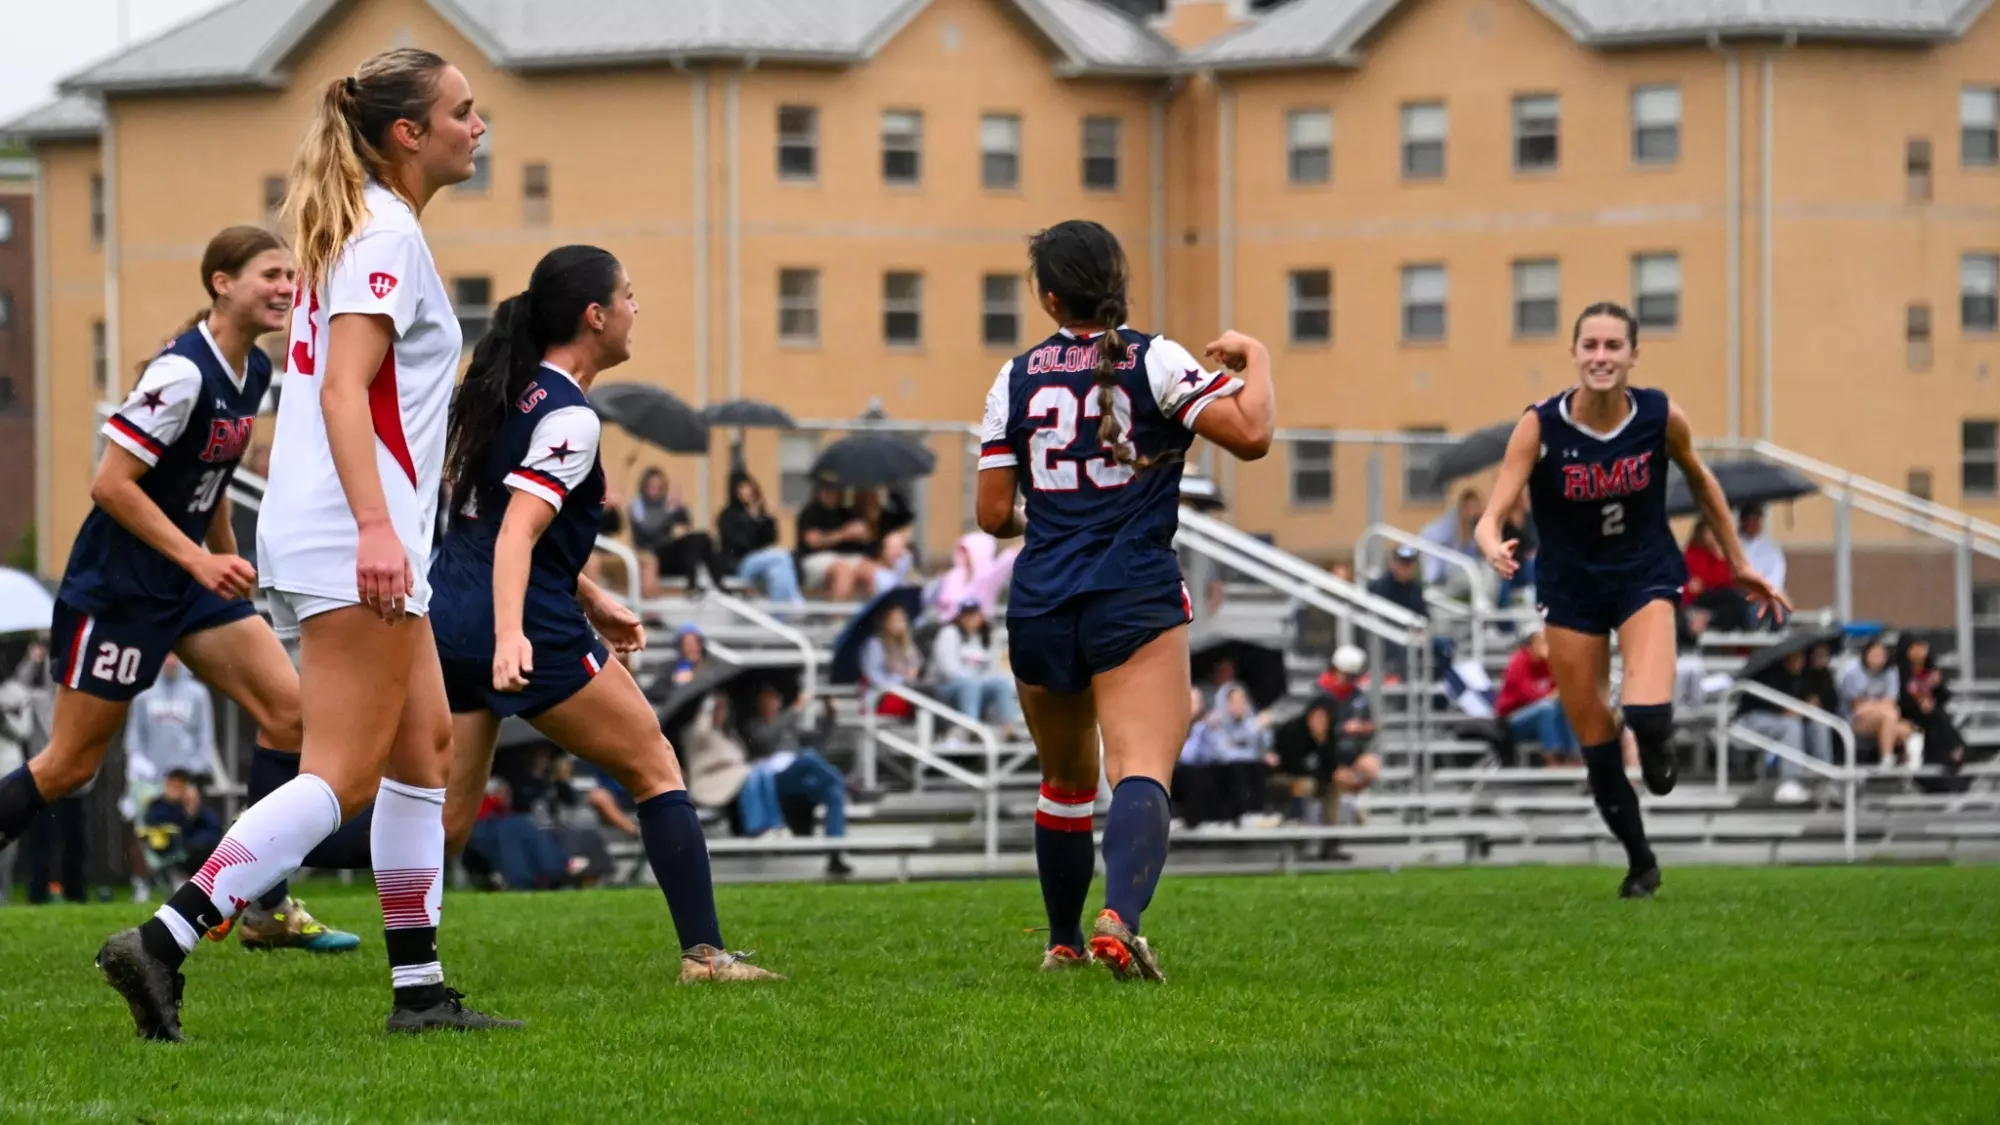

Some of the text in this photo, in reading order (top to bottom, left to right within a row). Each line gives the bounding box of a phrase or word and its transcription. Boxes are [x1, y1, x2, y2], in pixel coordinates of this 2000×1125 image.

[370, 274, 394, 295] H
[1027, 342, 1140, 374] COLONIS
[1028, 384, 1137, 493] 23
[1562, 450, 1653, 500] RMU
[1601, 502, 1626, 536] 2
[91, 640, 142, 686] 20
